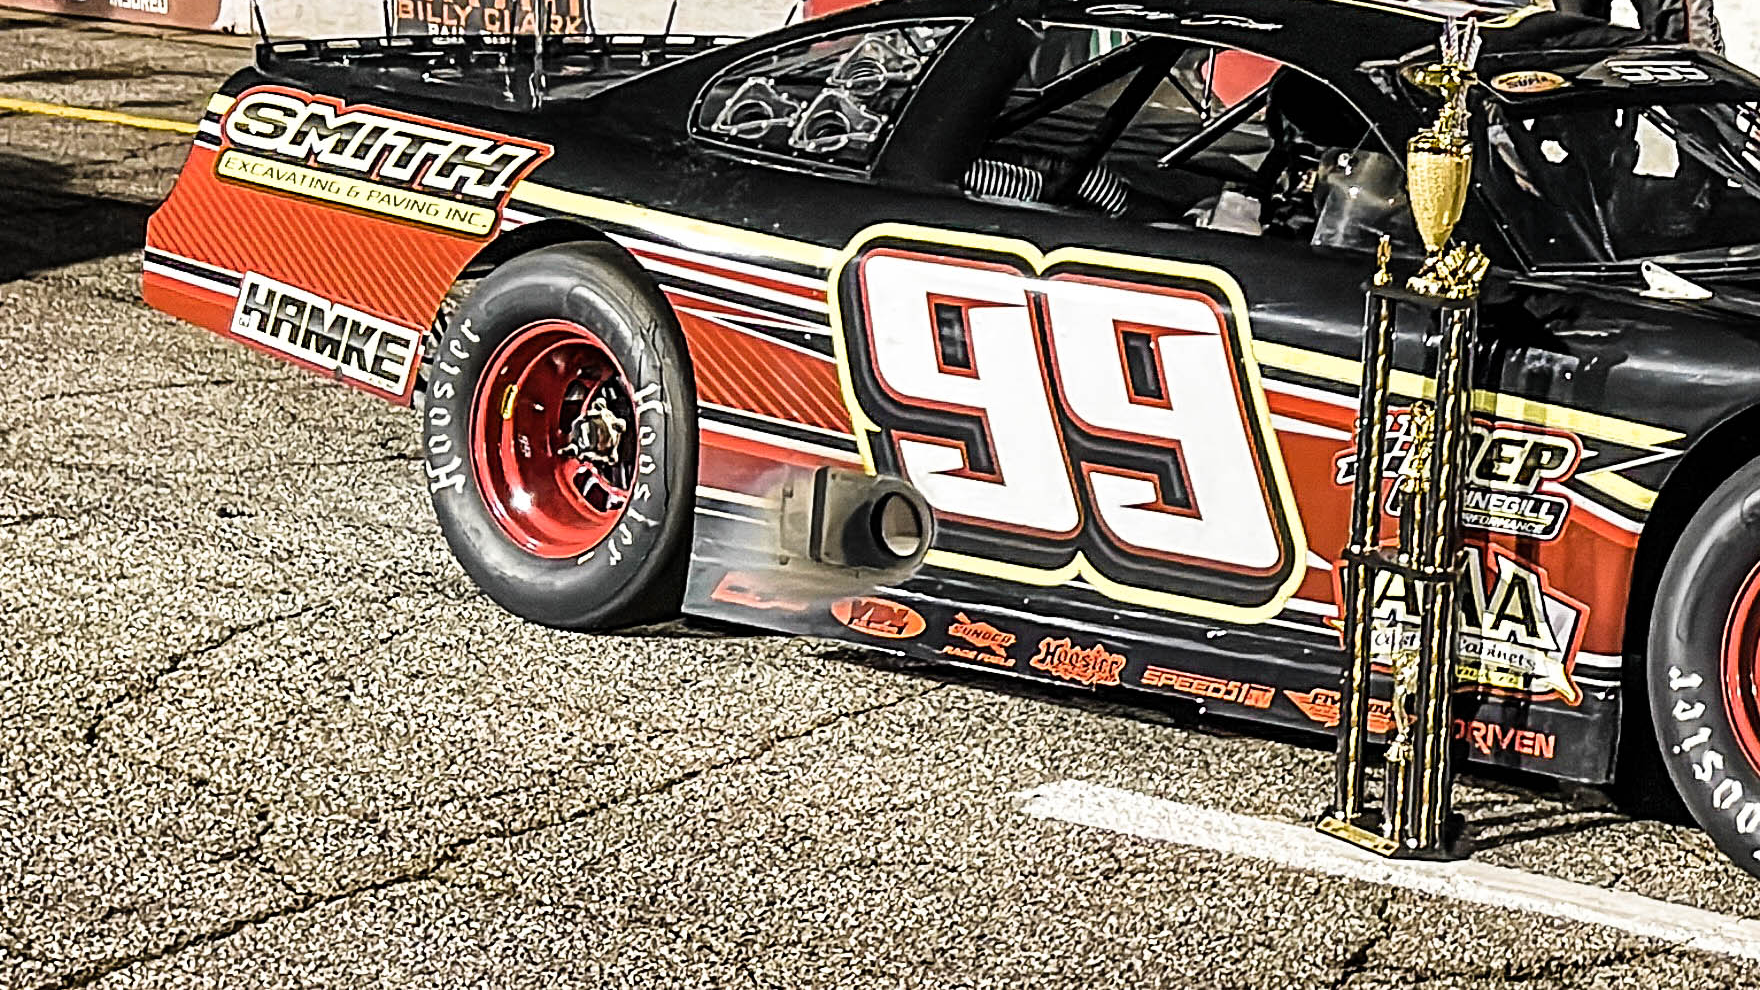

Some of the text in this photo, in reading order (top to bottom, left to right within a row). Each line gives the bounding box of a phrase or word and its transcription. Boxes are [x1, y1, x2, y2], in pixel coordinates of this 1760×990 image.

[224, 156, 341, 196] EXCAVATING
[365, 189, 440, 218] PAVING
[445, 208, 489, 229] INC.
[226, 92, 539, 200] SMITH
[242, 282, 412, 385] HAMKE
[429, 316, 481, 495] Hoosier
[858, 248, 1286, 579] 99
[950, 622, 1015, 647] SUNOCO
